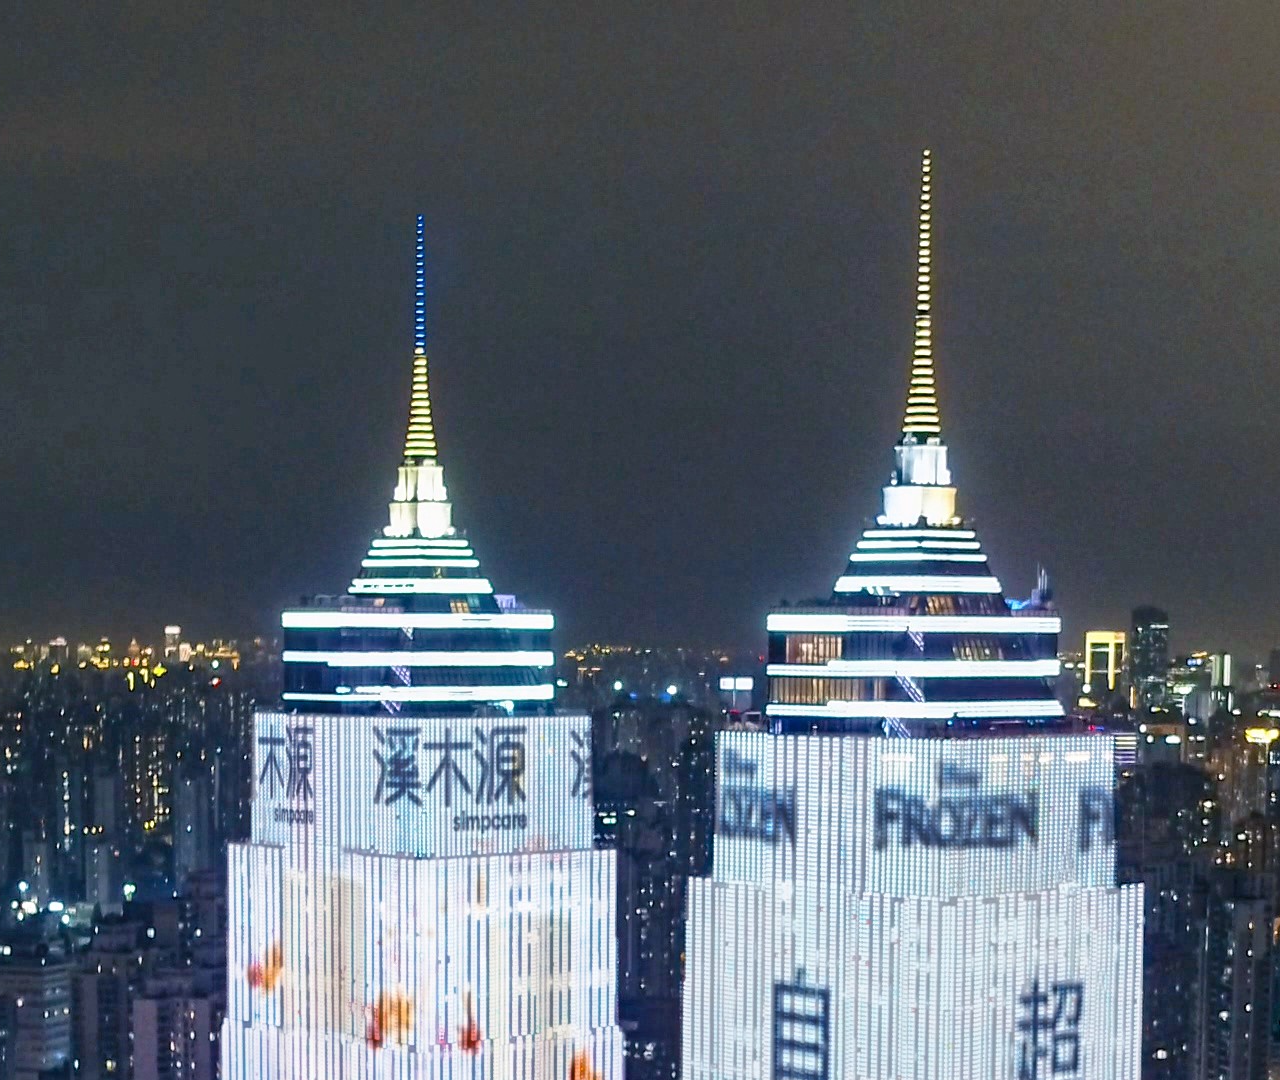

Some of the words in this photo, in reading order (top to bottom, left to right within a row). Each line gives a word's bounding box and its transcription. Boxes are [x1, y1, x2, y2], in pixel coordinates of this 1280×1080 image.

[373, 725, 527, 808] 溪木源
[453, 811, 528, 834] simpcare
[873, 784, 1039, 851] FROZEN
